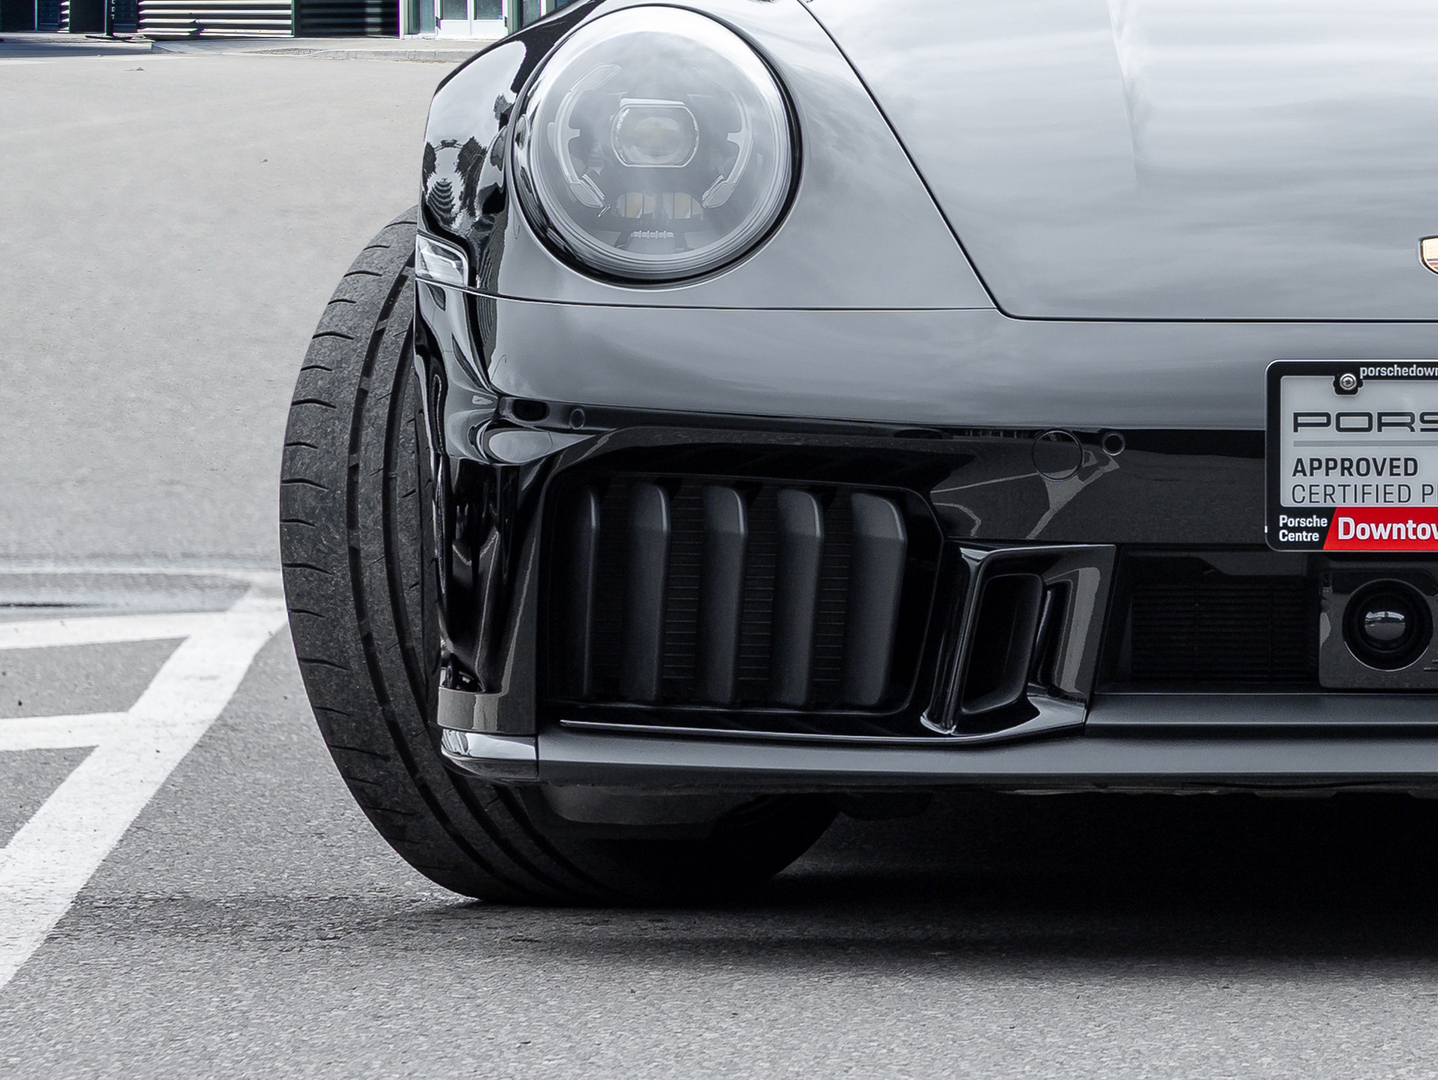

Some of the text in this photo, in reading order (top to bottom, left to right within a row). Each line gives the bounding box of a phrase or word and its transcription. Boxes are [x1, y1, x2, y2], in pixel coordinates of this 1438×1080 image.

[1292, 457, 1419, 477] APPROVED
[1291, 483, 1412, 503] CERTIFIED
[1279, 514, 1328, 528] Porsche
[1279, 529, 1320, 542] Centre
